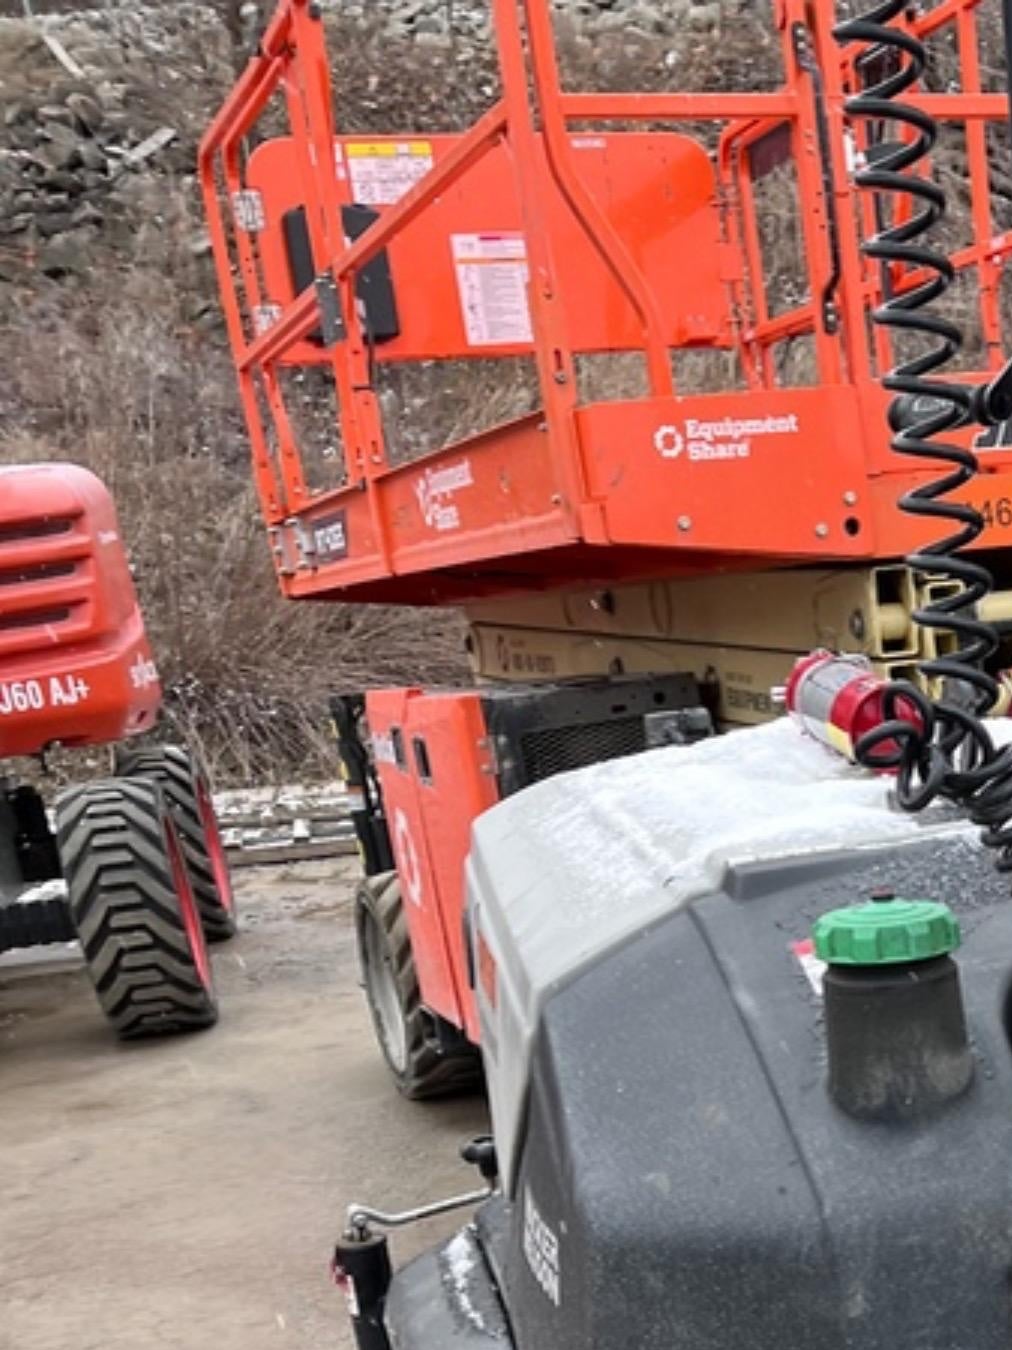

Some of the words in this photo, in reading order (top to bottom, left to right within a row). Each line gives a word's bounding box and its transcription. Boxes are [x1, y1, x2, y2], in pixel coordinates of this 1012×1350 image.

[685, 414, 799, 441] Equipment
[686, 440, 751, 461] Share
[49, 674, 90, 706] AJ+
